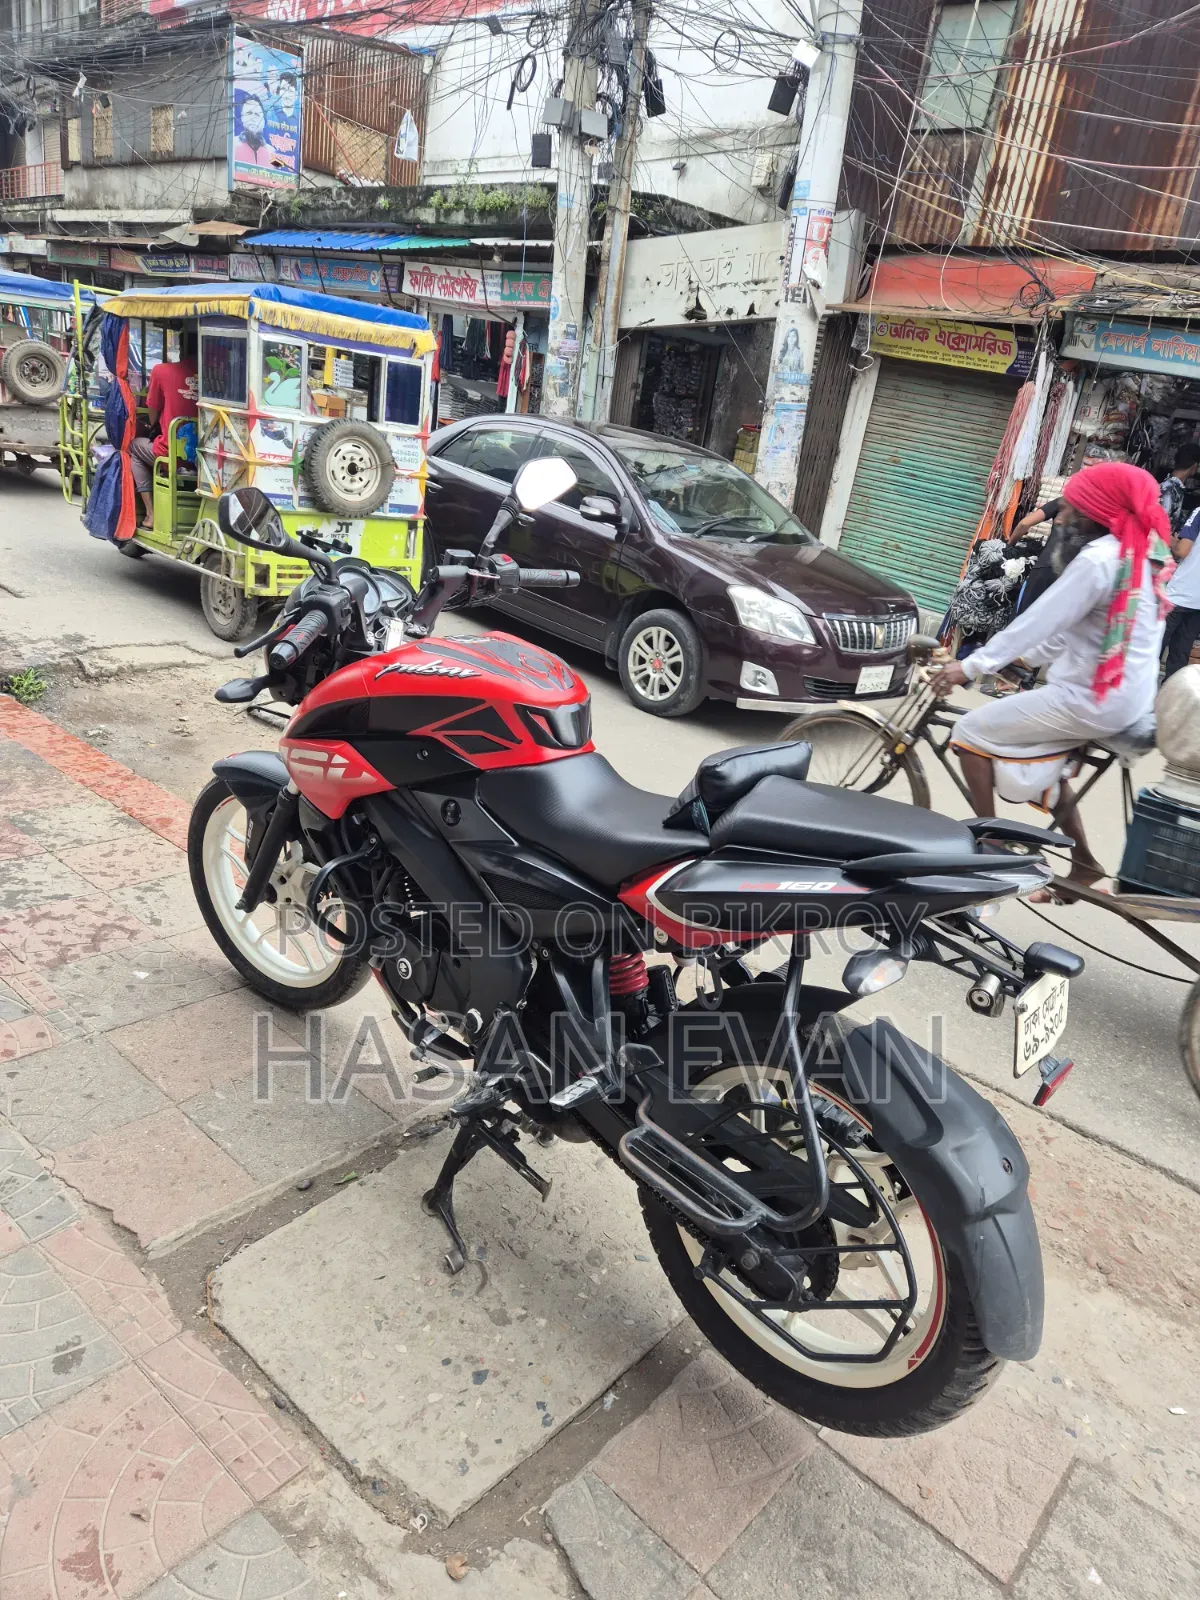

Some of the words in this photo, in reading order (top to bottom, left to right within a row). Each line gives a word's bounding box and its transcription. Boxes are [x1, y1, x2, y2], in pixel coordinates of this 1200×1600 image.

[510, 281, 535, 301] সবুজ
[889, 318, 931, 343] অনিক
[1098, 330, 1151, 355] মেসার্স
